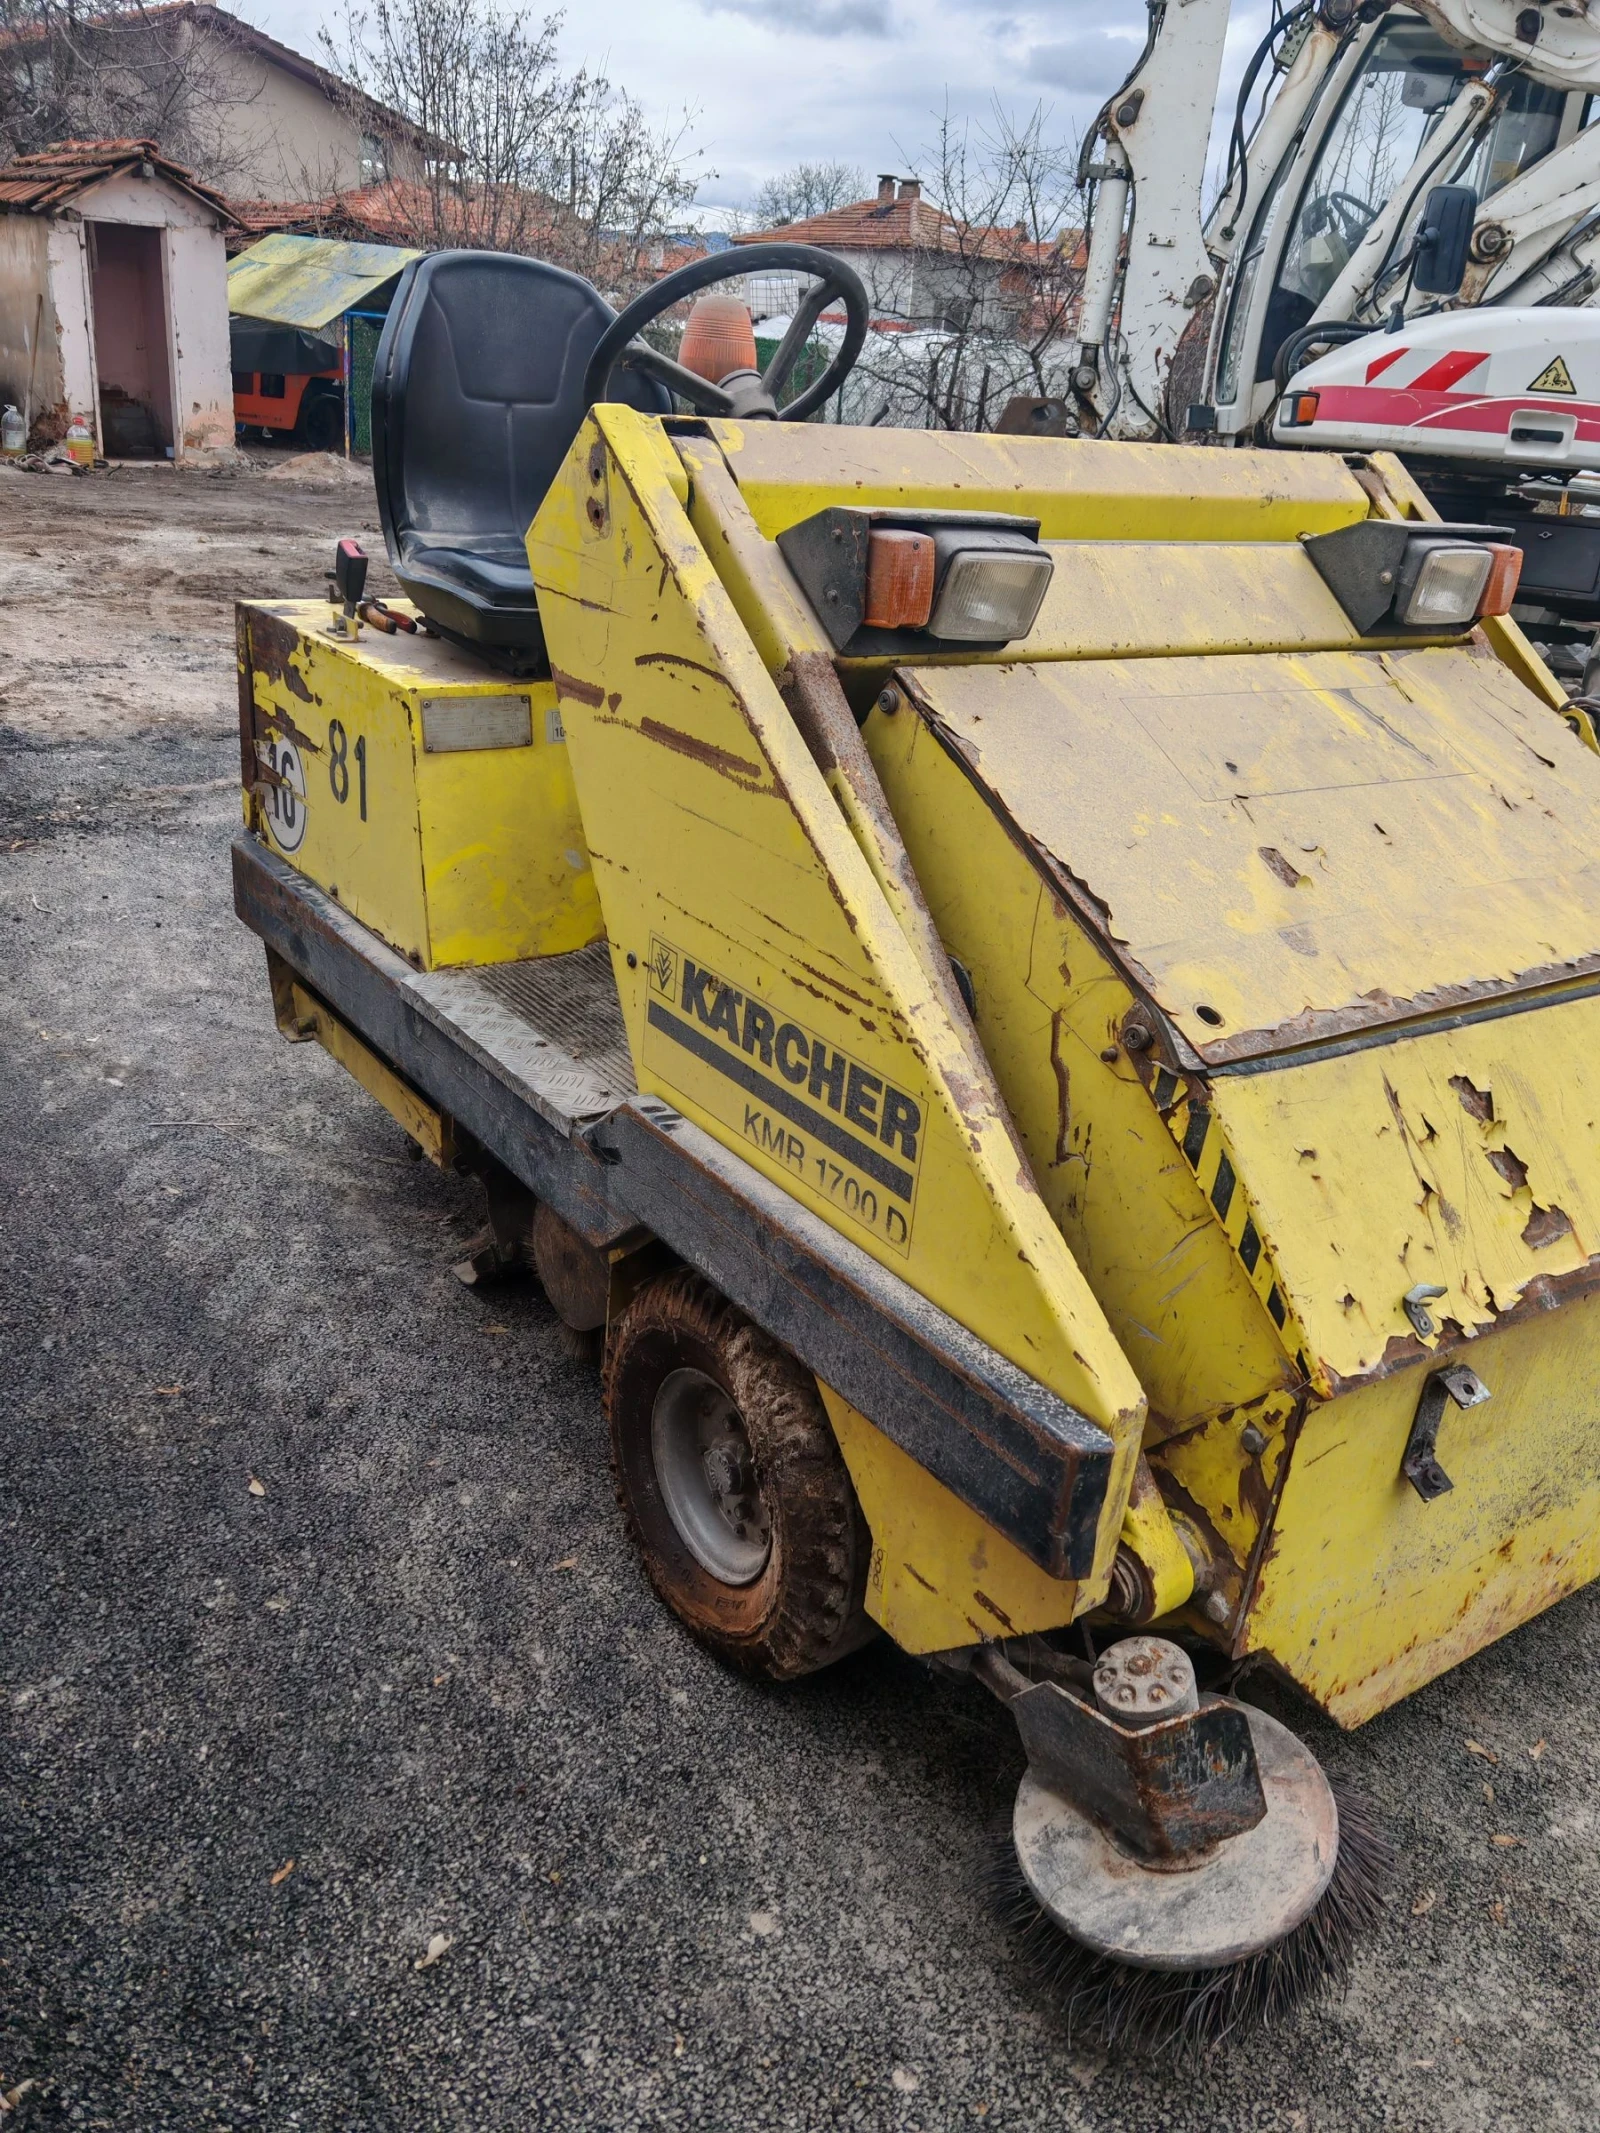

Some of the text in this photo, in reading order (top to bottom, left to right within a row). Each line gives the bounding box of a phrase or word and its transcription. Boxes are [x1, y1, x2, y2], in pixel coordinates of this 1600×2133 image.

[328, 718, 367, 823] 81
[681, 958, 921, 1163] KÄRCHER
[743, 1103, 908, 1245] KMR 1700 D
